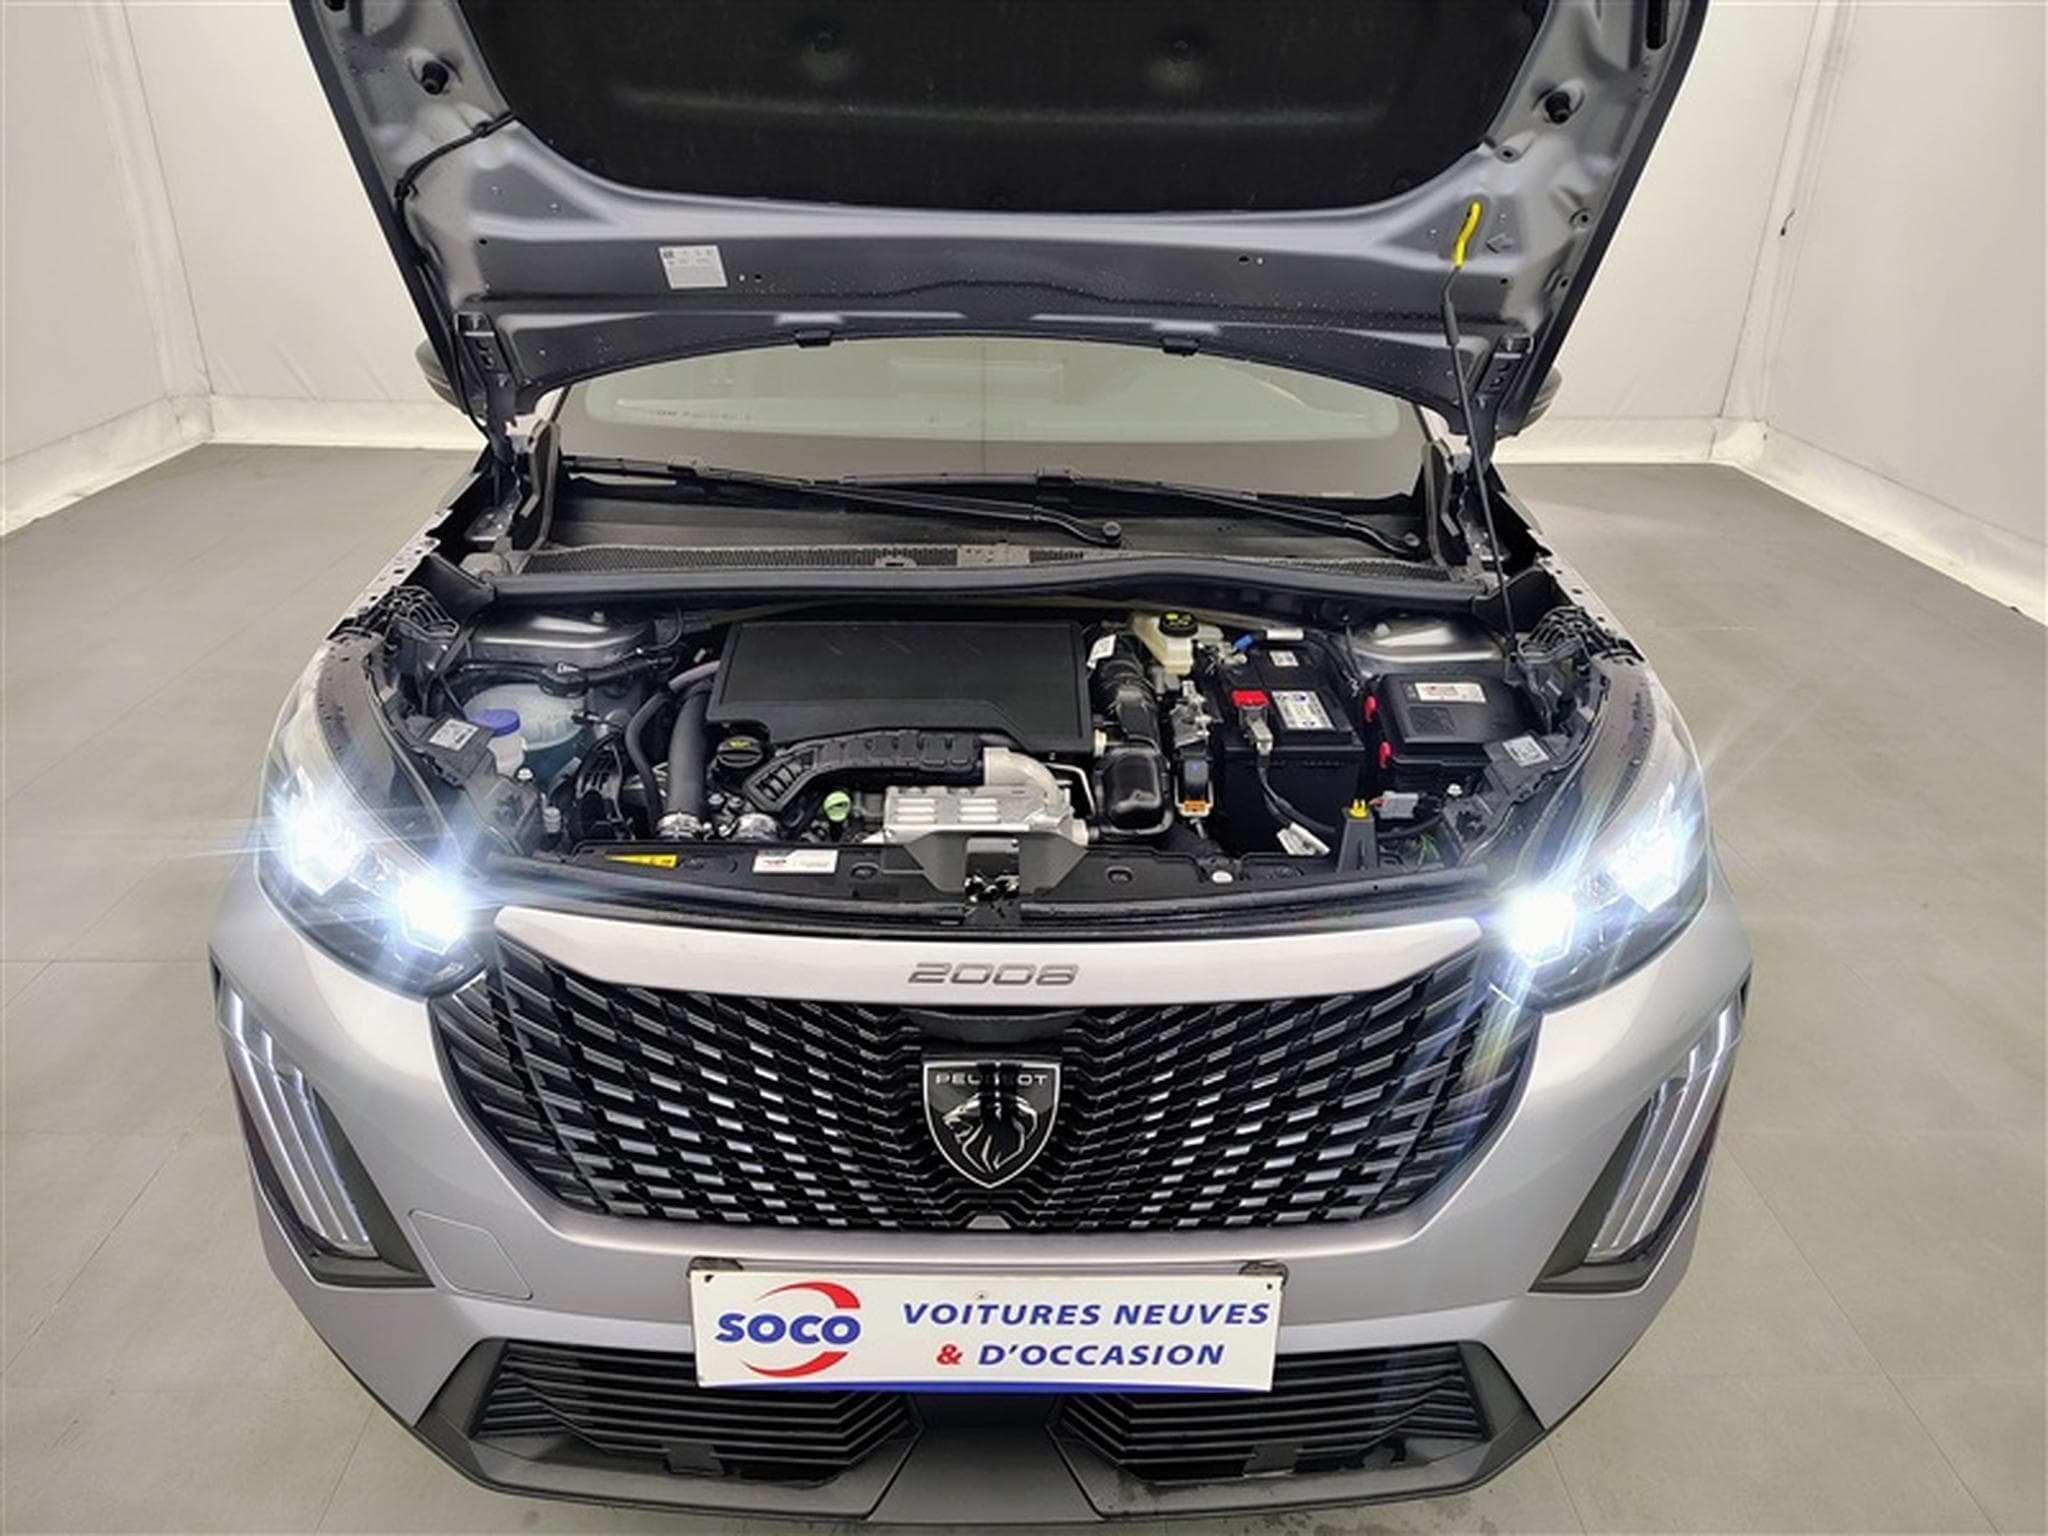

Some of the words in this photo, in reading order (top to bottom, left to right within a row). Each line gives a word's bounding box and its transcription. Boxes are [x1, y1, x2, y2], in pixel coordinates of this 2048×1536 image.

[908, 963, 1079, 987] 2008
[934, 1072, 1049, 1087] PEUOT
[903, 1303, 1101, 1327] VOITURES
[1113, 1303, 1269, 1326] NEUVES
[715, 1311, 862, 1346] SOCO
[935, 1344, 964, 1366] &
